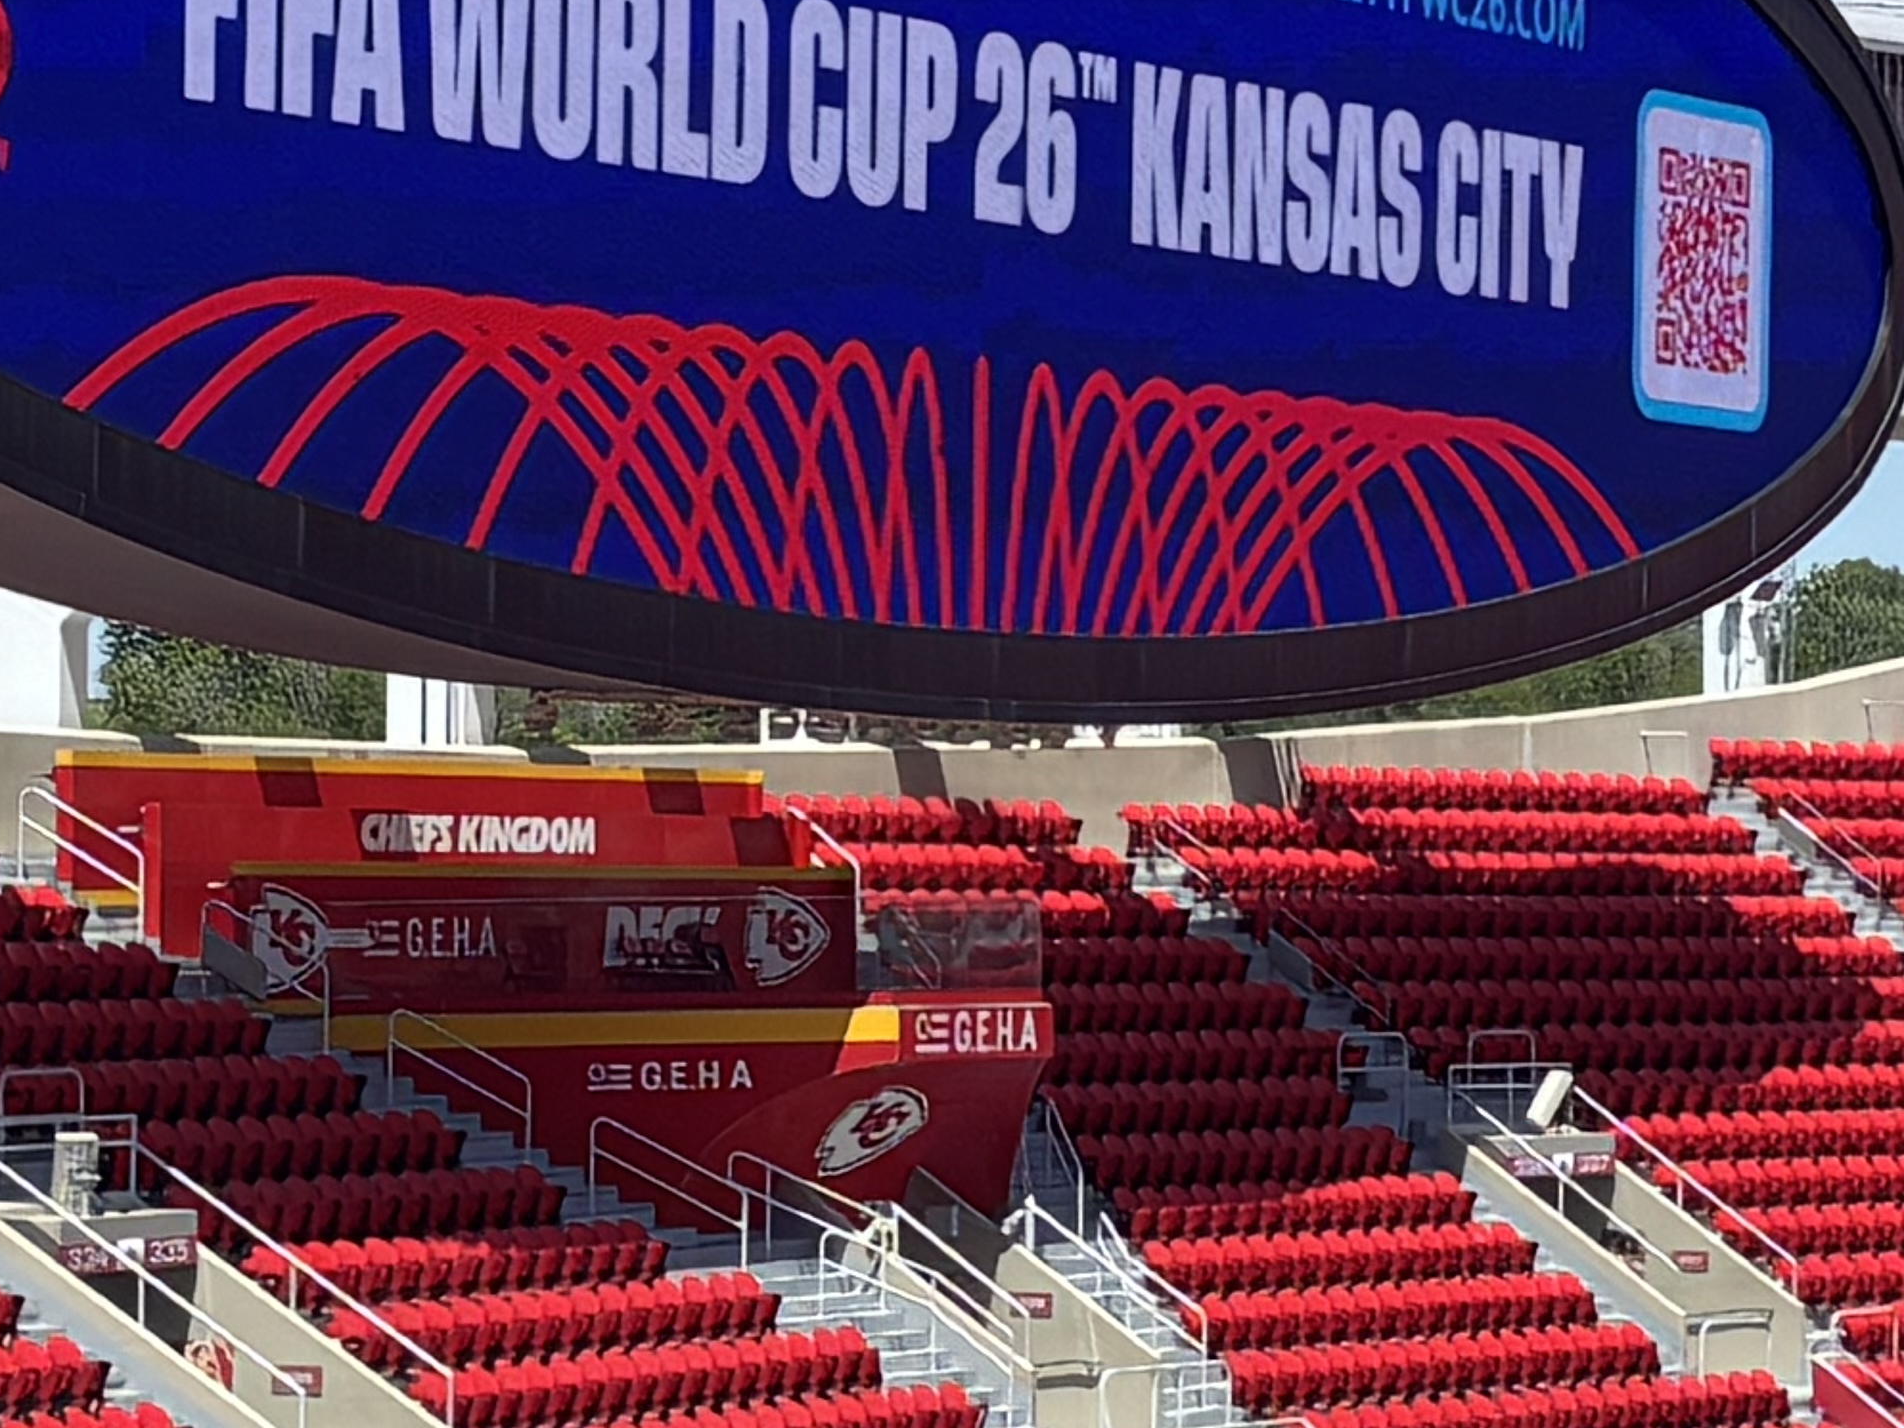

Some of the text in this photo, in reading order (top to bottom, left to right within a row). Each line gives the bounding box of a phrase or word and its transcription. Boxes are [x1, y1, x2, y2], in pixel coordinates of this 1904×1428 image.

[1131, 61, 1422, 289] KANSAS
[1436, 120, 1584, 309] CITY
[360, 813, 595, 855] CHIEFS KINGDOM
